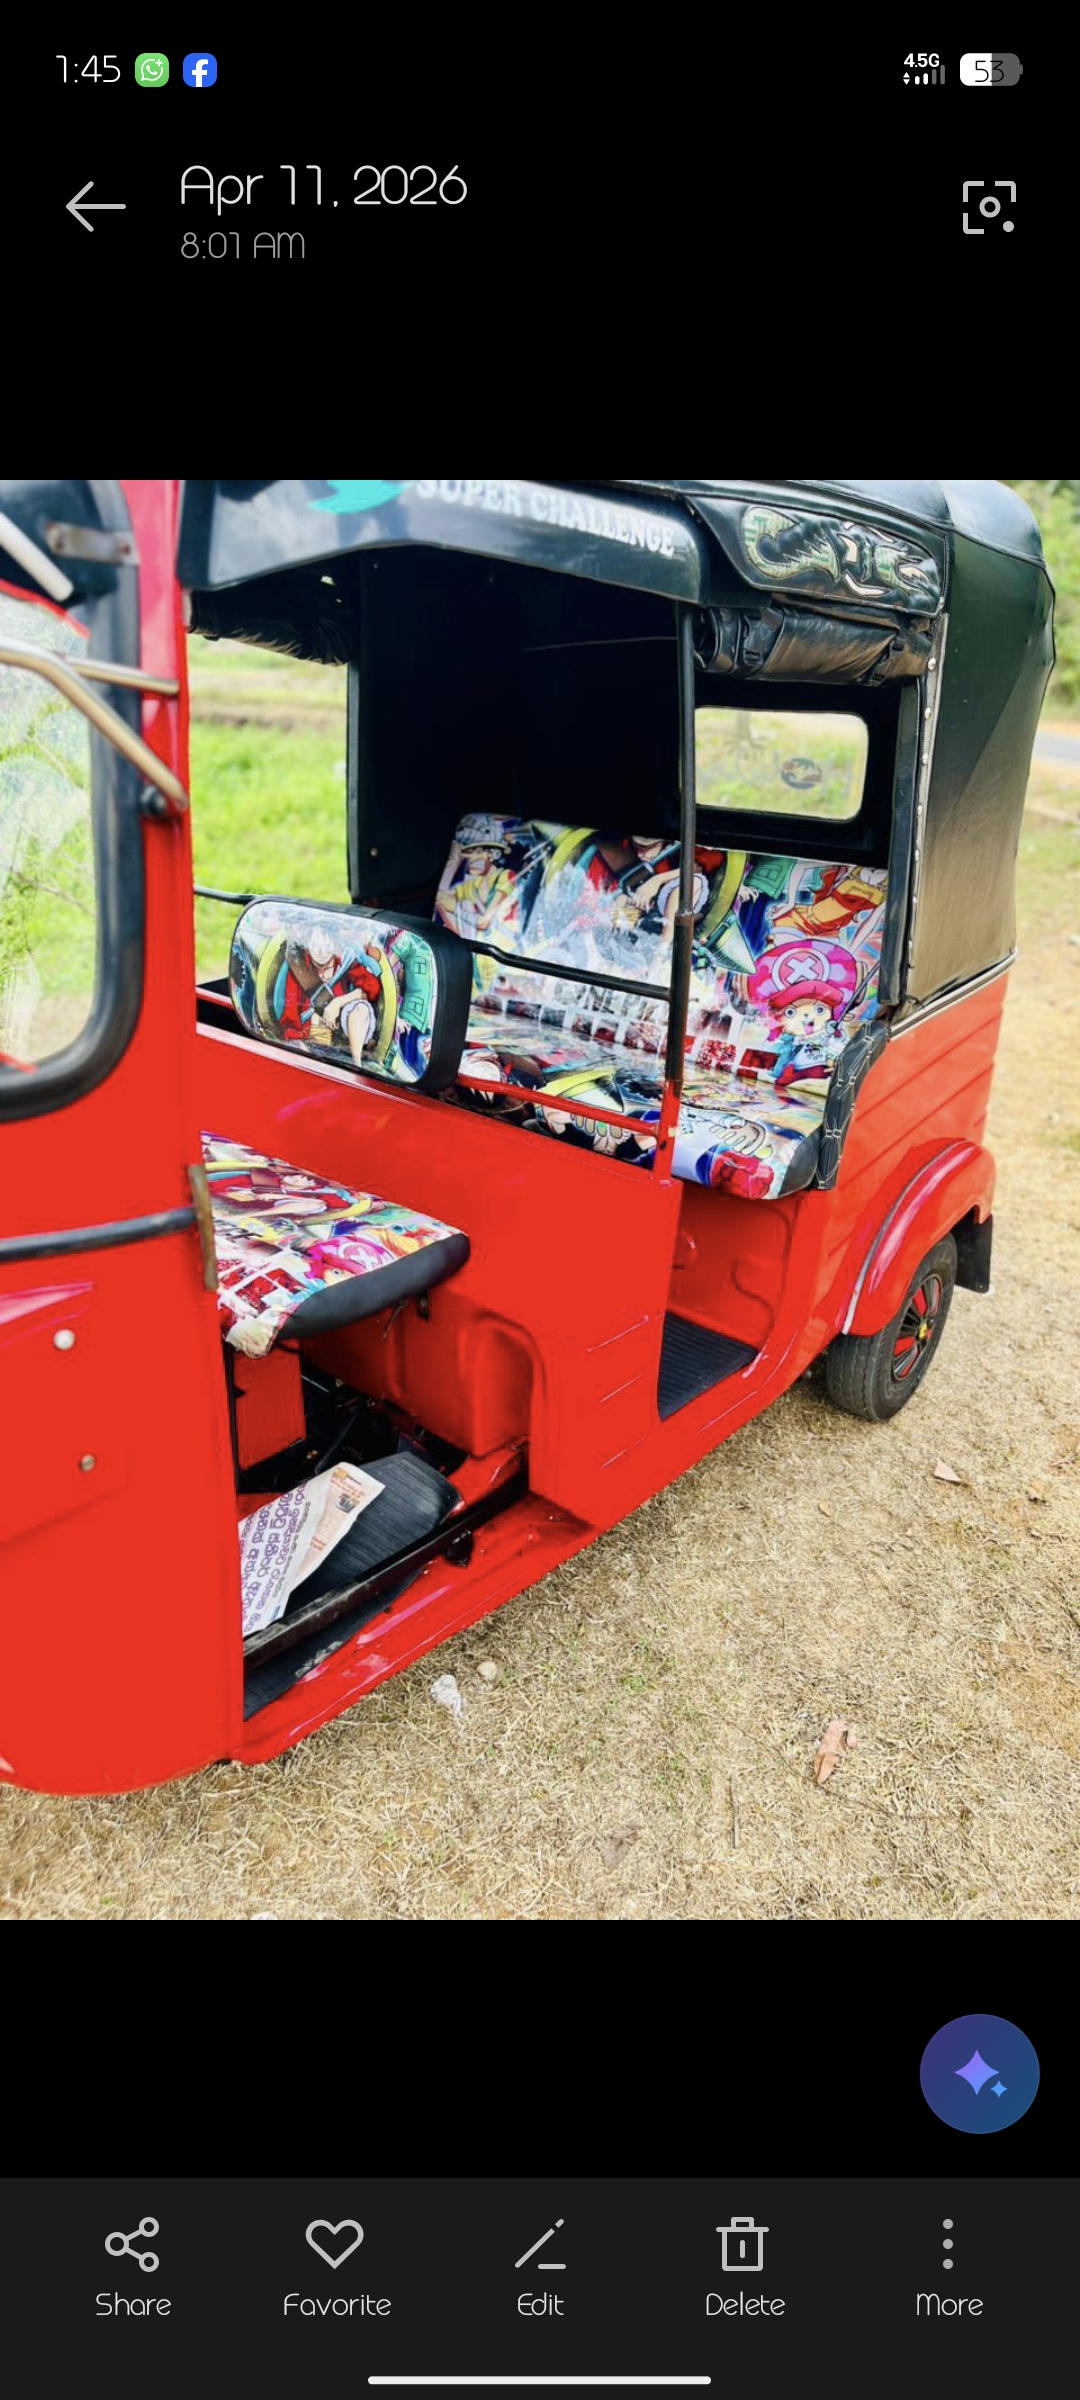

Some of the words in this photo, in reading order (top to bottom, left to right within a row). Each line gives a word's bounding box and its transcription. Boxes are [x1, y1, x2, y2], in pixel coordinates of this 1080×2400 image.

[56, 55, 121, 83] 1:45
[904, 53, 940, 68] 4.5G
[975, 60, 1004, 82] 53
[181, 165, 264, 216] Apr
[280, 165, 338, 207] 11,
[354, 165, 467, 205] 2026
[181, 232, 239, 259] 8:01
[254, 232, 304, 258] AM
[415, 480, 523, 517] SUPER
[529, 490, 675, 557] CHALLENGE
[96, 2292, 171, 2316] Share
[284, 2292, 391, 2316] Favorite
[518, 2292, 564, 2316] Edit
[706, 2291, 785, 2316] Delete
[917, 2292, 983, 2316] More
